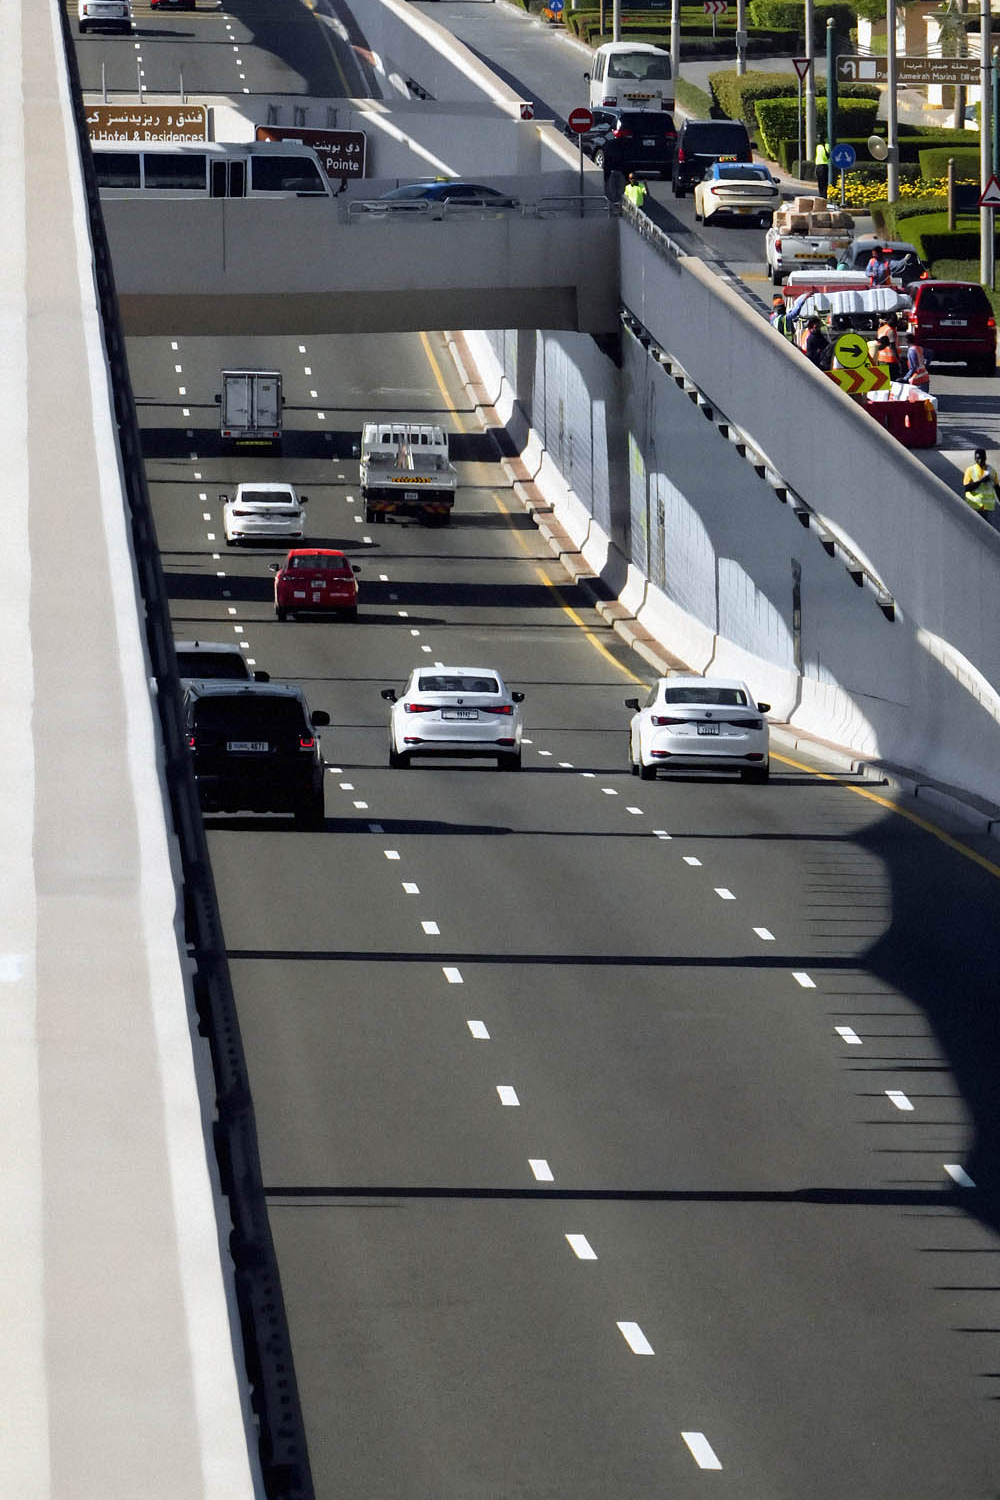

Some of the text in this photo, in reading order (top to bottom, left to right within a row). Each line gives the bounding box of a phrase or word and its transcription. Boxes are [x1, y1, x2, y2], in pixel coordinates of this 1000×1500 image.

[932, 72, 957, 81] Marina
[166, 115, 173, 125] و
[175, 110, 203, 127] فندق
[99, 130, 129, 141] Hotel
[133, 131, 141, 141] &
[144, 129, 205, 141] Residences
[312, 140, 341, 154] بوينت
[326, 158, 360, 171] Pointe
